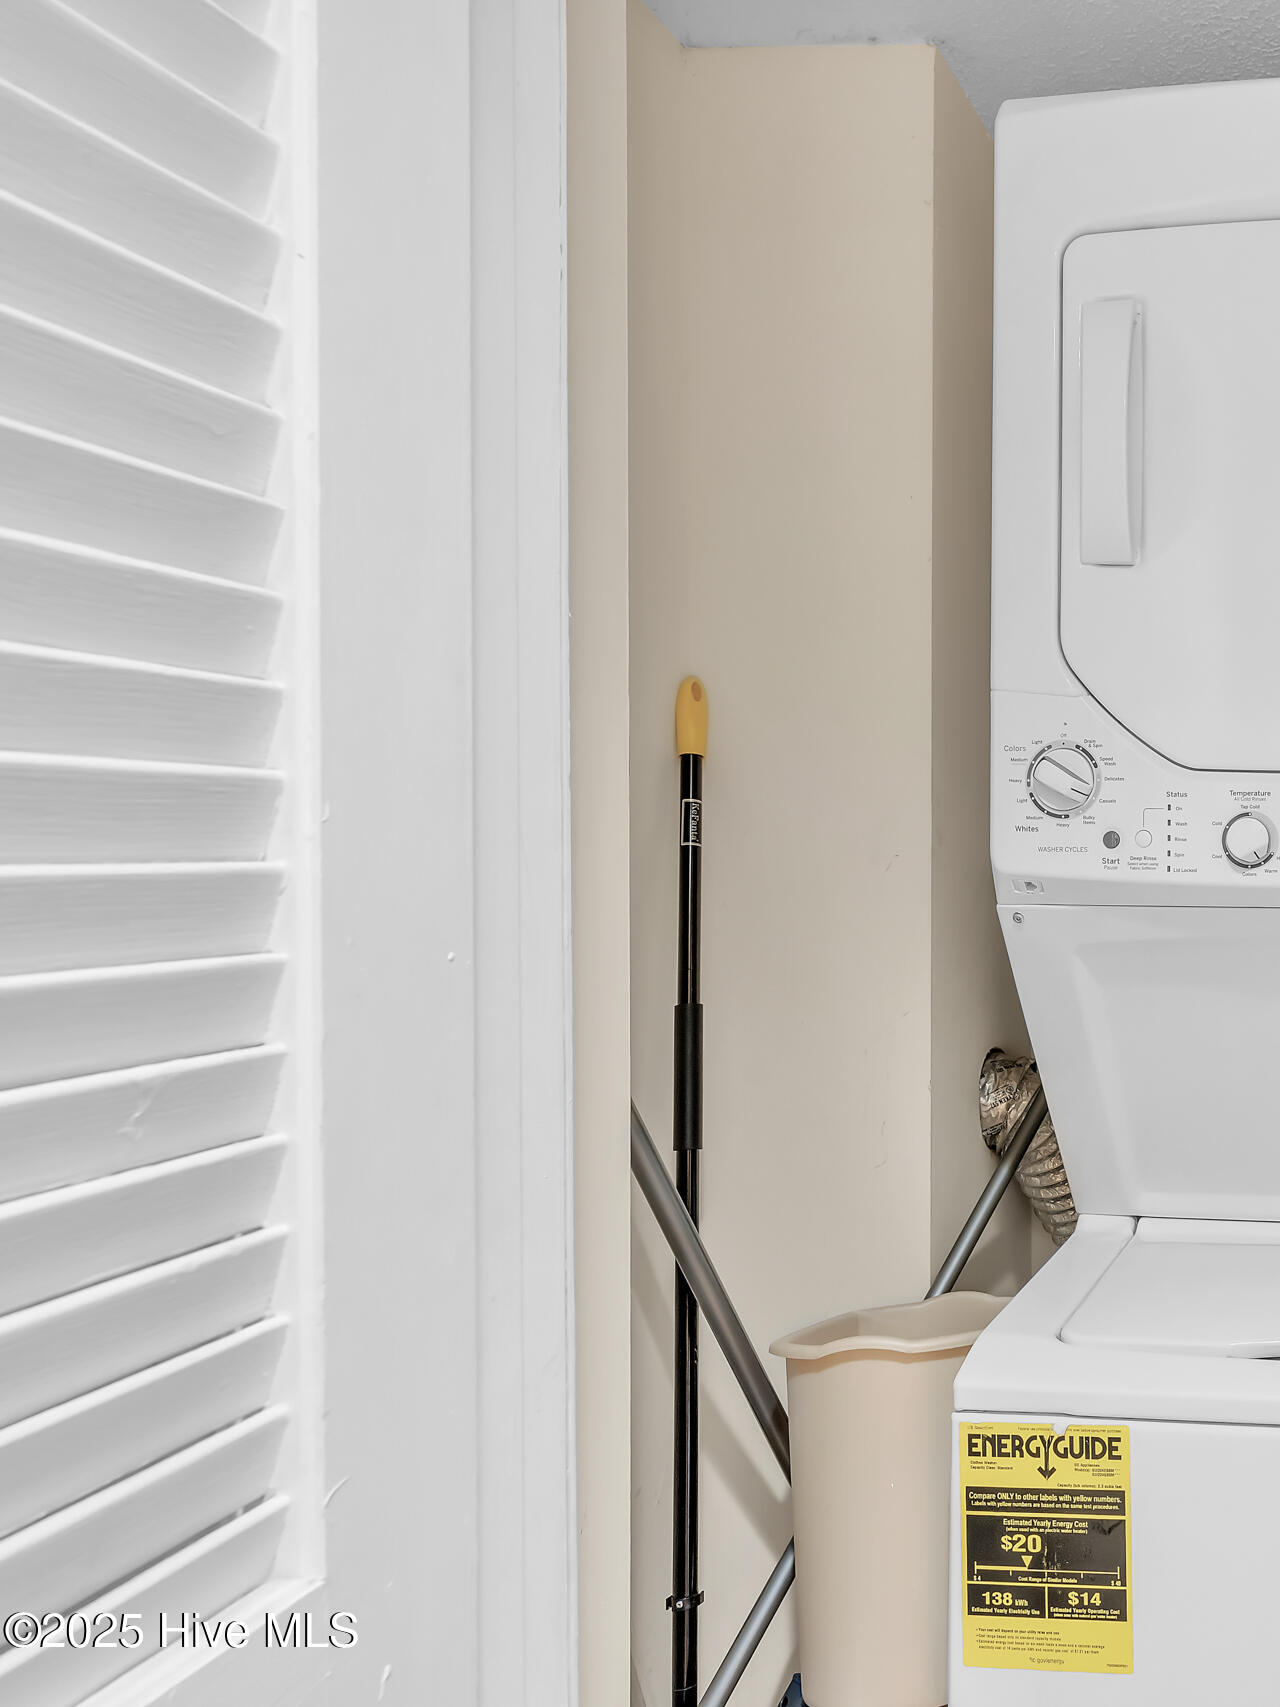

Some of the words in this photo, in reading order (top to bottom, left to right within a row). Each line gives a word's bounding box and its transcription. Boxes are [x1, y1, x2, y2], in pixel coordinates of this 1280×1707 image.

[1102, 857, 1120, 865] Start
[968, 1433, 1122, 1462] ENERGYGUIDE
[969, 1491, 996, 1501] Compare
[997, 1492, 1014, 1500] ONLY
[1040, 1493, 1058, 1501] labels
[1073, 1495, 1092, 1503] yellow
[1033, 1520, 1051, 1529] Yearly
[1052, 1520, 1073, 1529] Energy
[1001, 1534, 1042, 1553] $20
[982, 1591, 1013, 1606] 138
[1068, 1591, 1101, 1606] $14
